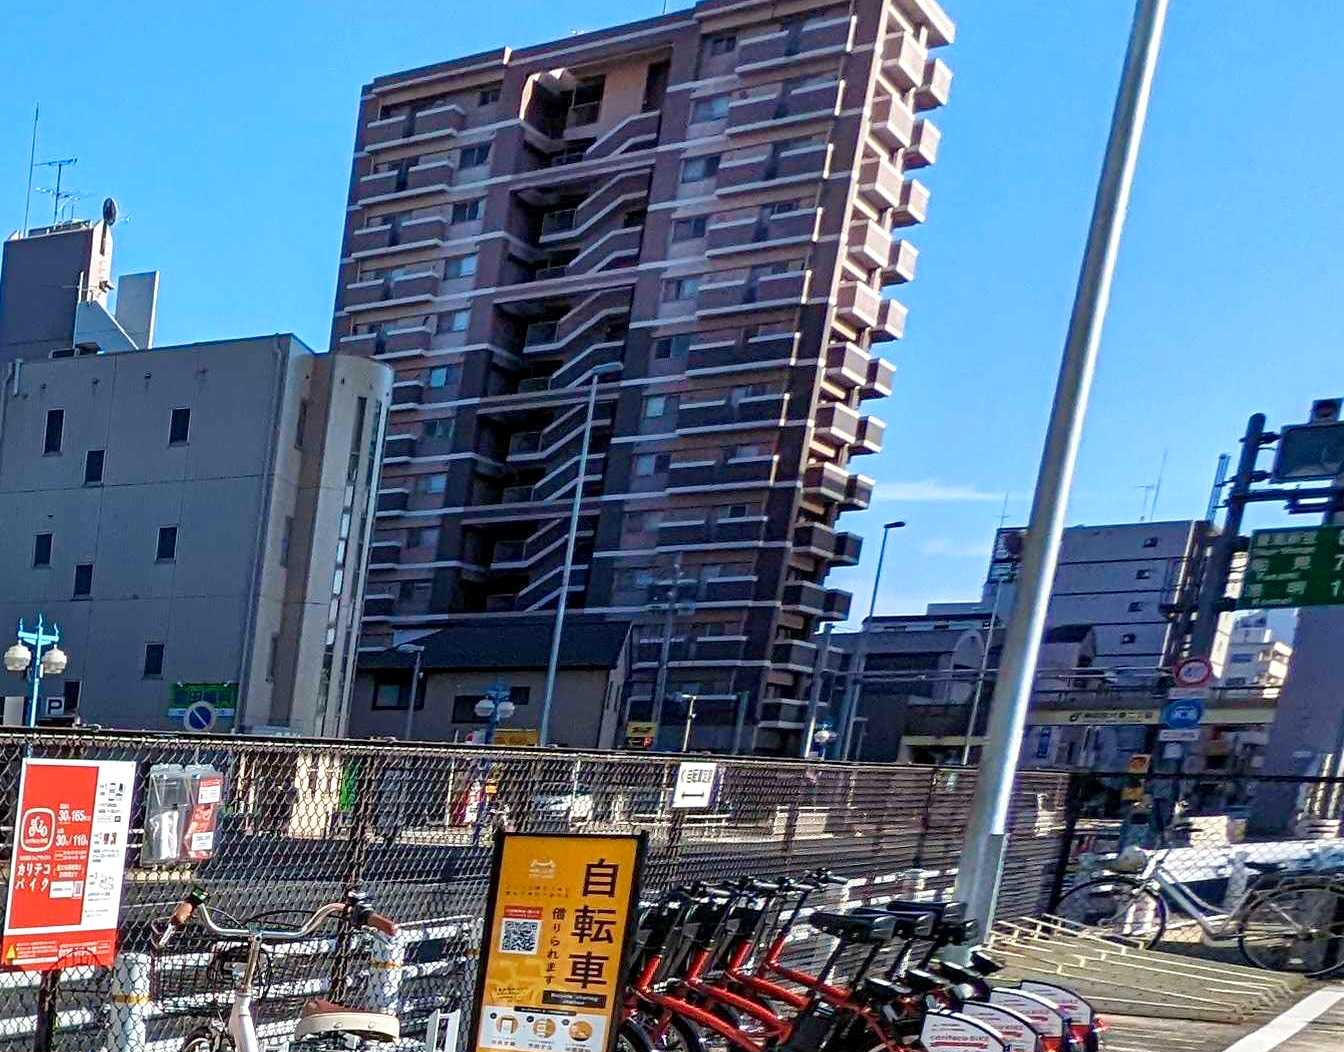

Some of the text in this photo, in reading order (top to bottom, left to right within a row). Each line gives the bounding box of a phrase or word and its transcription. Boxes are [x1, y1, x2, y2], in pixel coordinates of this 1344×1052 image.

[48, 699, 62, 714] P
[16, 862, 51, 877] カリテコ
[15, 878, 49, 892] バイク
[564, 858, 620, 989] 自転車
[543, 907, 567, 985] 借りられます
